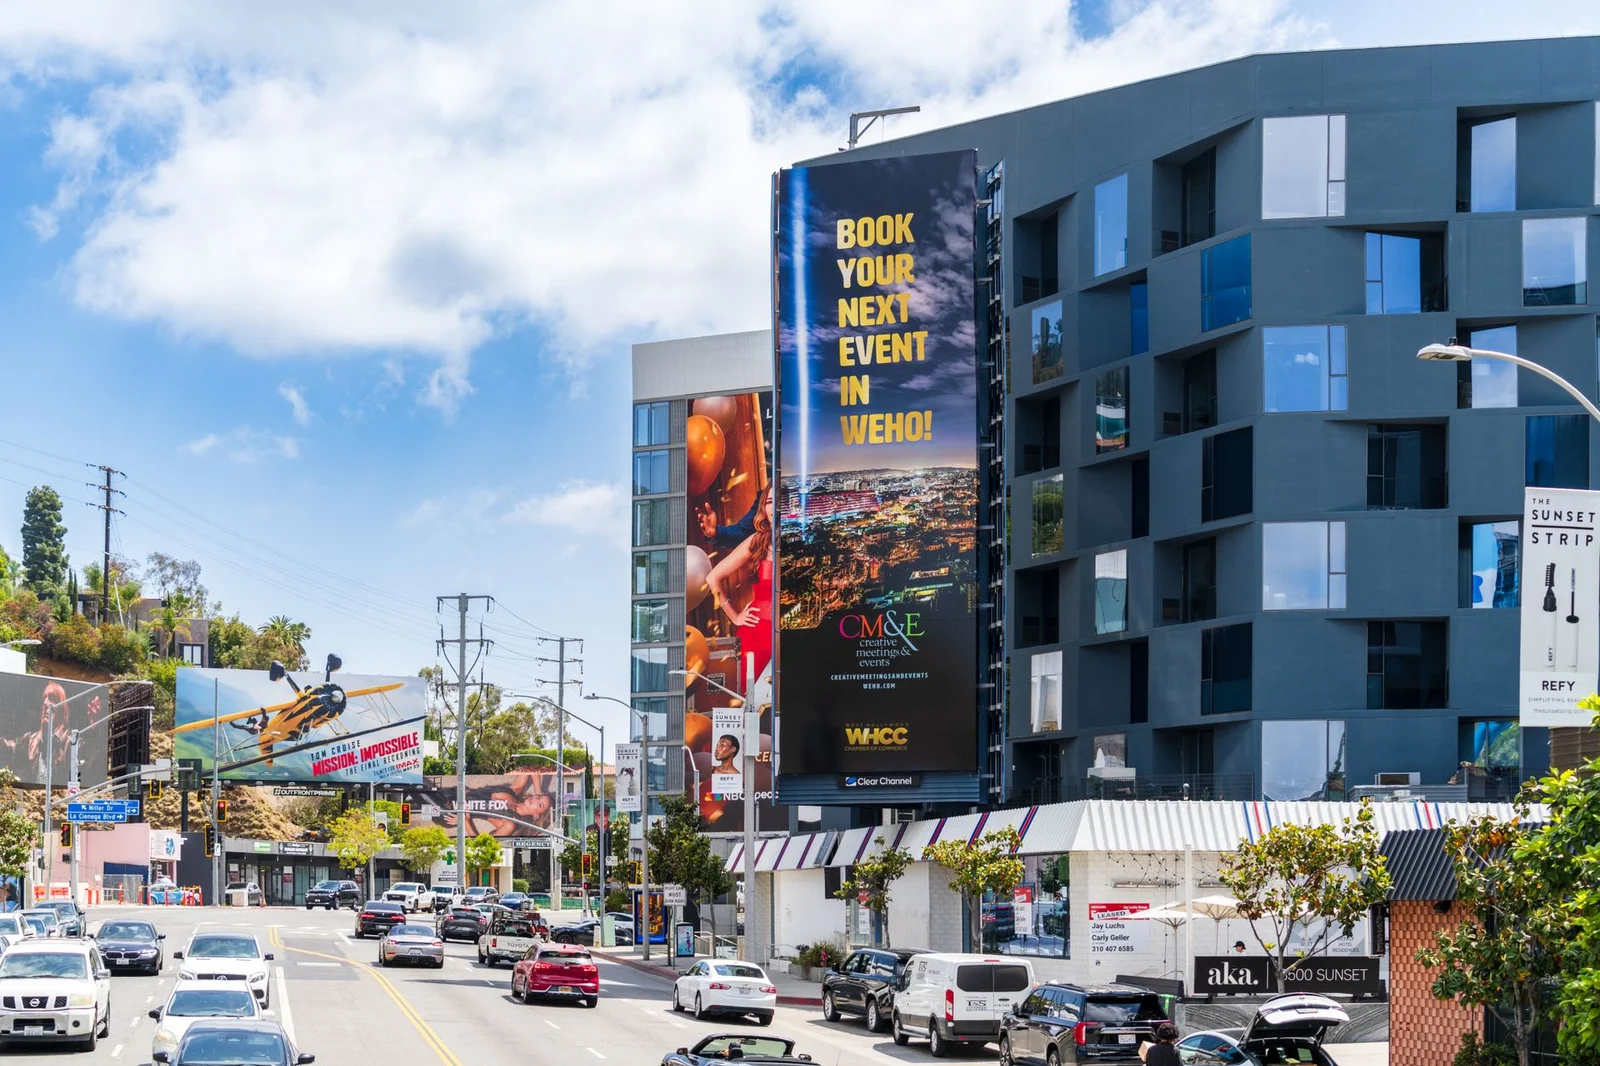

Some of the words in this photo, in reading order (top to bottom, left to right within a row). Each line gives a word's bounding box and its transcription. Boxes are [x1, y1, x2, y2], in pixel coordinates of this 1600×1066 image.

[837, 213, 914, 249] BOOK
[837, 253, 914, 288] YOUR
[838, 292, 911, 328] NEXT
[839, 331, 928, 367] EVENT
[840, 374, 869, 406] IN
[840, 410, 932, 446] WEHO!
[1532, 509, 1596, 523] SUNSET
[1531, 532, 1594, 546] STRIP
[839, 610, 925, 651] CM&E
[859, 637, 897, 648] creative
[856, 647, 900, 658] meetings
[900, 646, 911, 656] &
[859, 658, 890, 667] events
[830, 672, 928, 681] CREATIVEMEETINGSANDEVENTS
[1541, 680, 1576, 692] REFY
[845, 727, 908, 745] WHCC
[311, 750, 327, 761] TOM
[331, 740, 360, 755] CRUISE
[312, 751, 358, 777] MISSION:
[360, 732, 419, 763] IMPOSSIBLE
[345, 766, 357, 776] THE
[360, 759, 380, 772] FINAL
[383, 747, 420, 764] RECKONING
[395, 758, 418, 769] IMAX
[857, 777, 878, 786] Clear
[879, 776, 912, 786] Channel
[488, 800, 508, 810] FOX
[1097, 911, 1126, 919] LEASED
[1091, 934, 1109, 942] Carly
[1207, 961, 1258, 986] aka.
[1316, 968, 1368, 981] SUNSET
